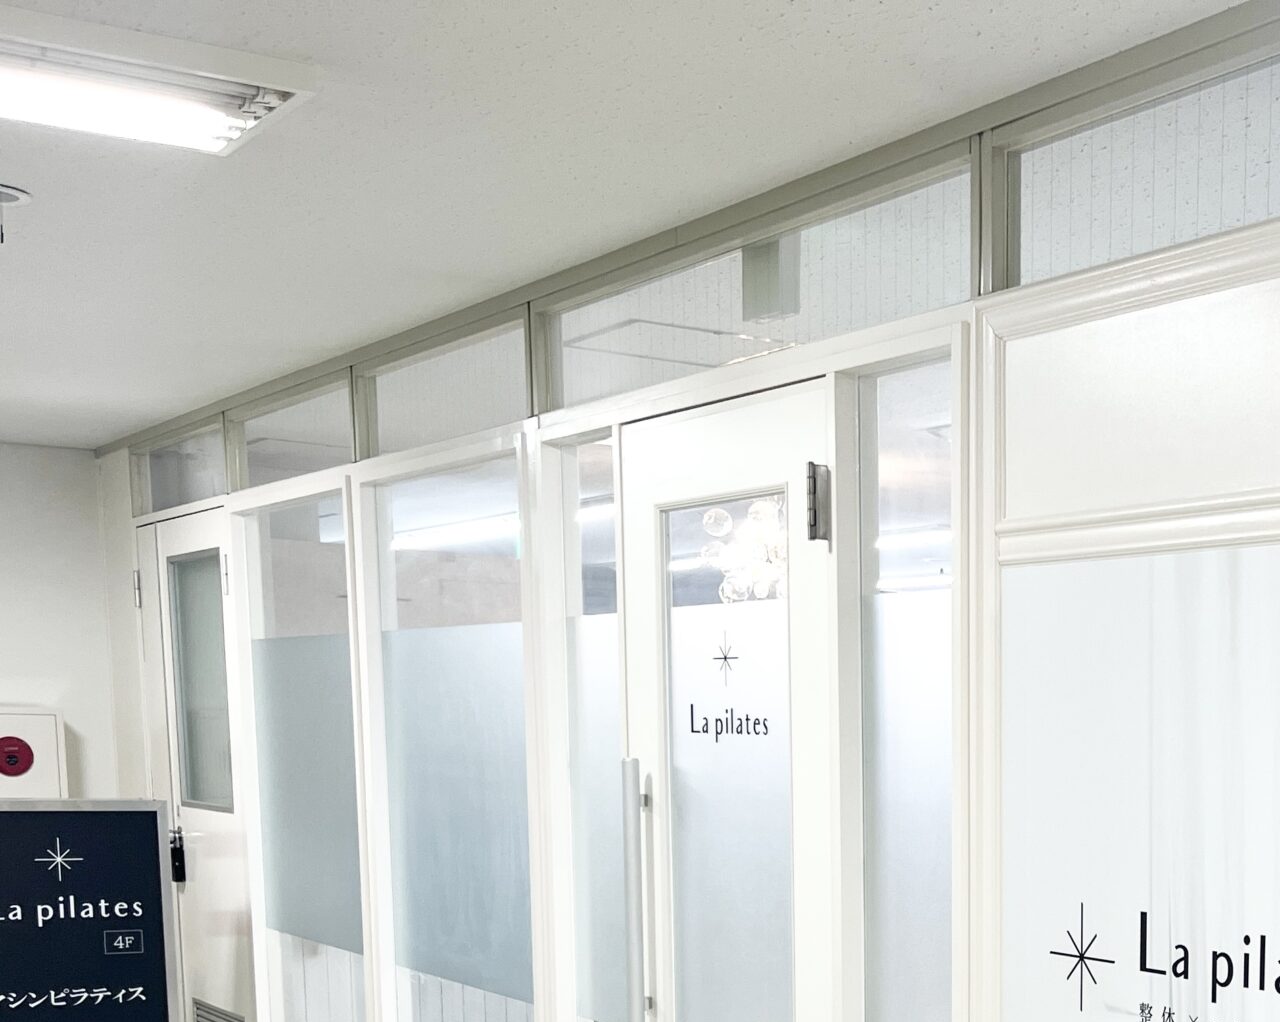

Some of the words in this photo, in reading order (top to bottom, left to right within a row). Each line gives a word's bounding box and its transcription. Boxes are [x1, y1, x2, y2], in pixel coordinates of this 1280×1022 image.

[690, 703, 709, 735] La
[714, 707, 769, 744] pilates
[0, 904, 23, 921] a
[37, 895, 143, 928] pilates
[113, 935, 135, 949] 4F
[1139, 910, 1190, 980] La
